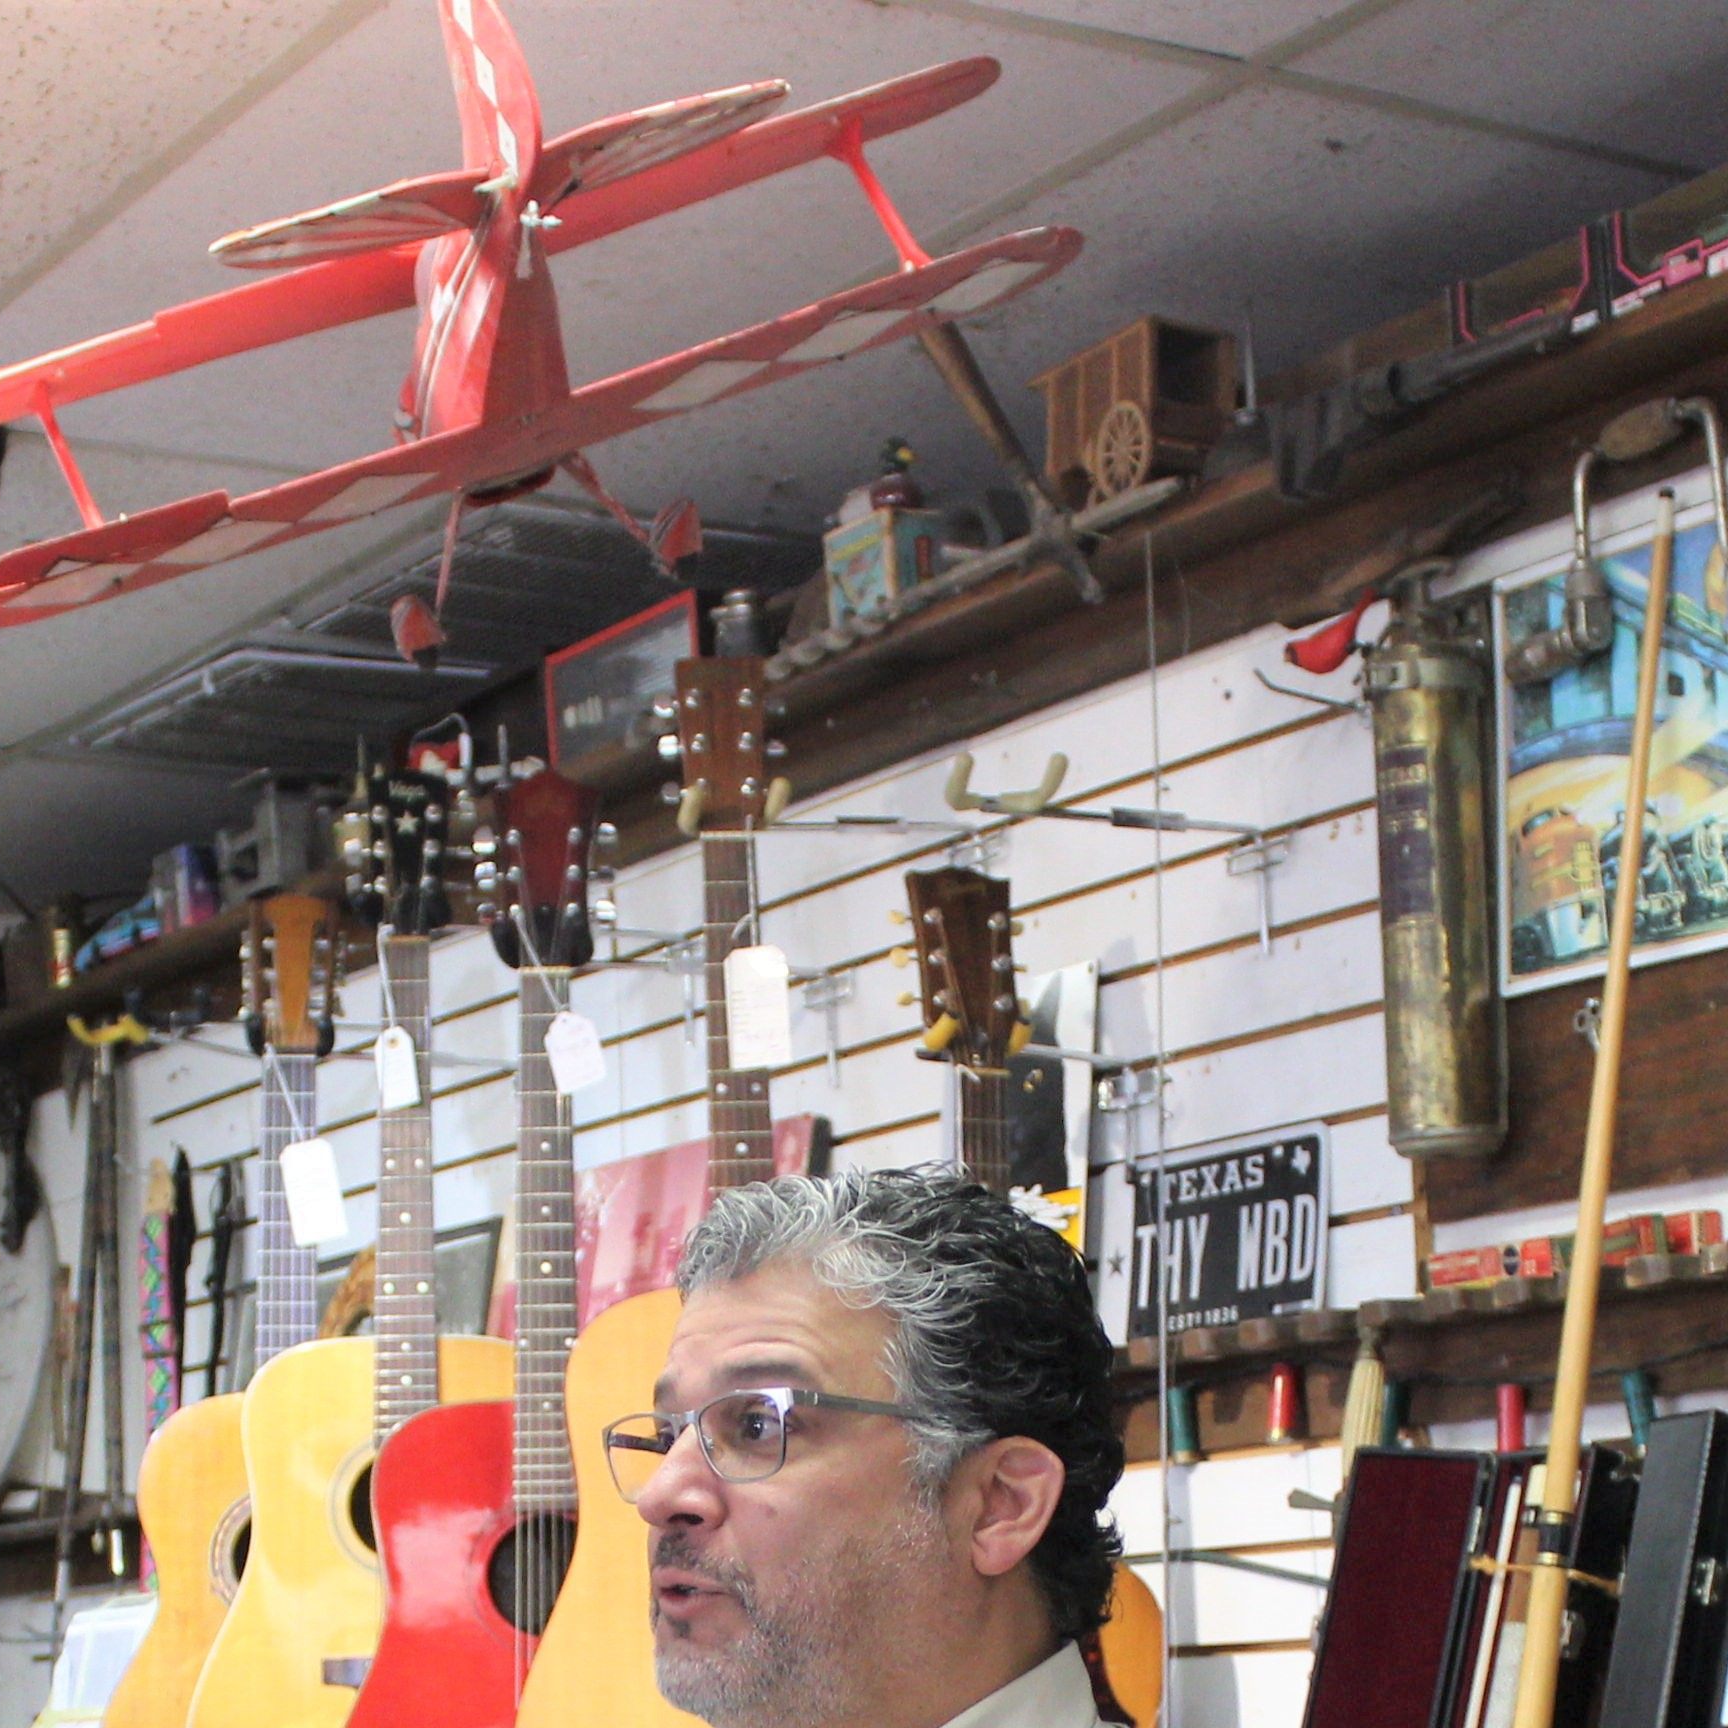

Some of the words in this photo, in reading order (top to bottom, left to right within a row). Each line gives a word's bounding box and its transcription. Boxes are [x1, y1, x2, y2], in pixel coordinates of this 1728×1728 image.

[1159, 1153, 1265, 1205] TEXAS
[1136, 1213, 1210, 1311] THY
[1204, 1306, 1239, 1326] 1836
